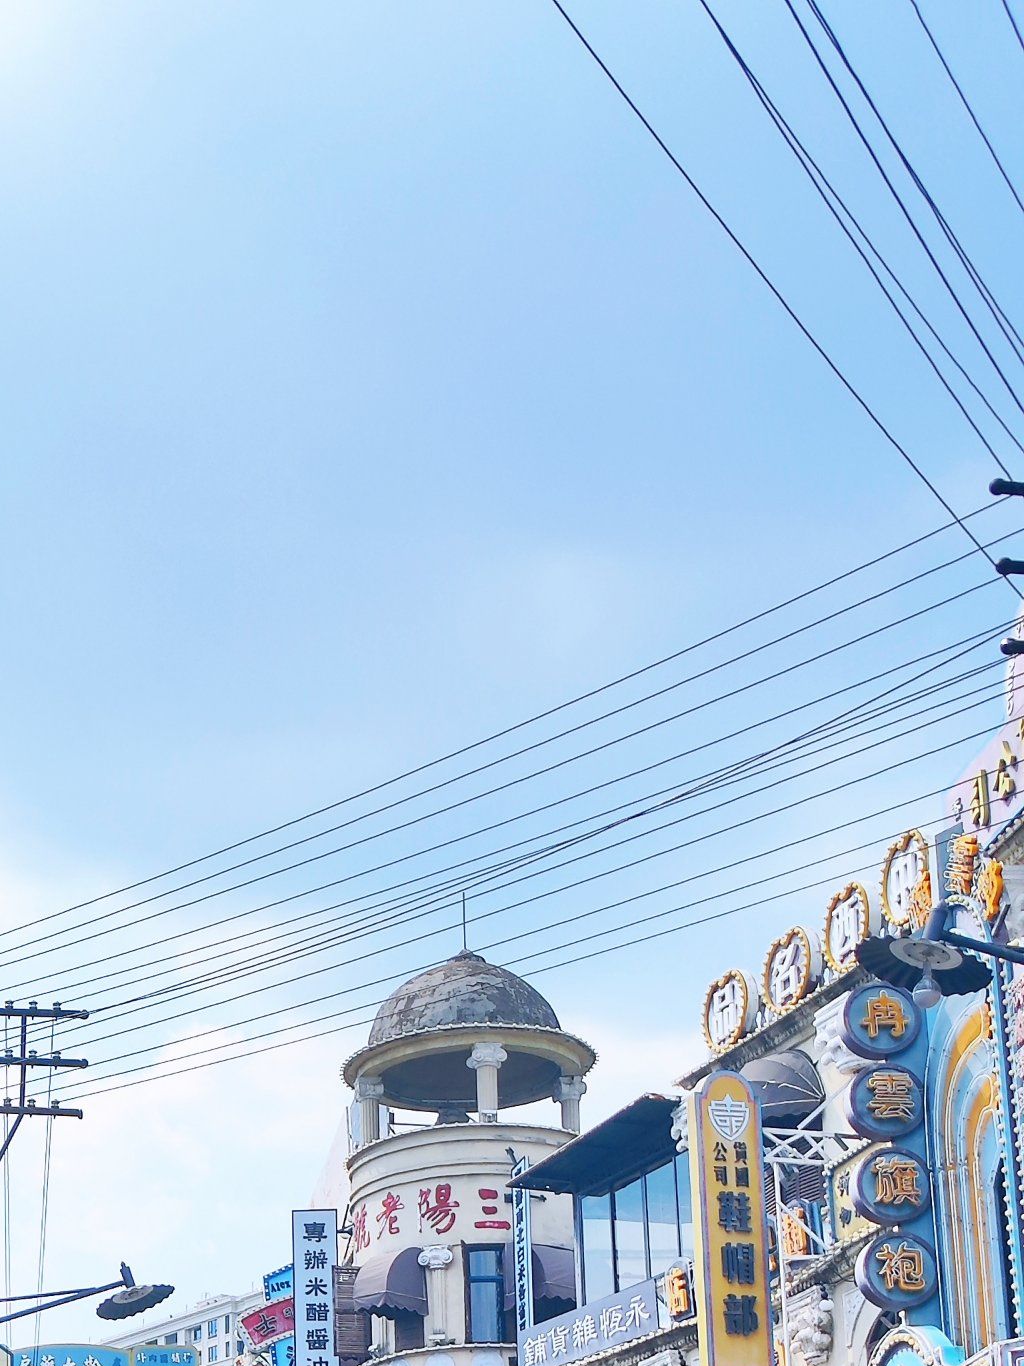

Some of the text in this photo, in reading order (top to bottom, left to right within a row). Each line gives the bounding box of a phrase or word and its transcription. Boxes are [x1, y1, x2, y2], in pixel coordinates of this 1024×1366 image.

[270, 1279, 292, 1294] Alex
[717, 1191, 759, 1336] 鞋帽部
